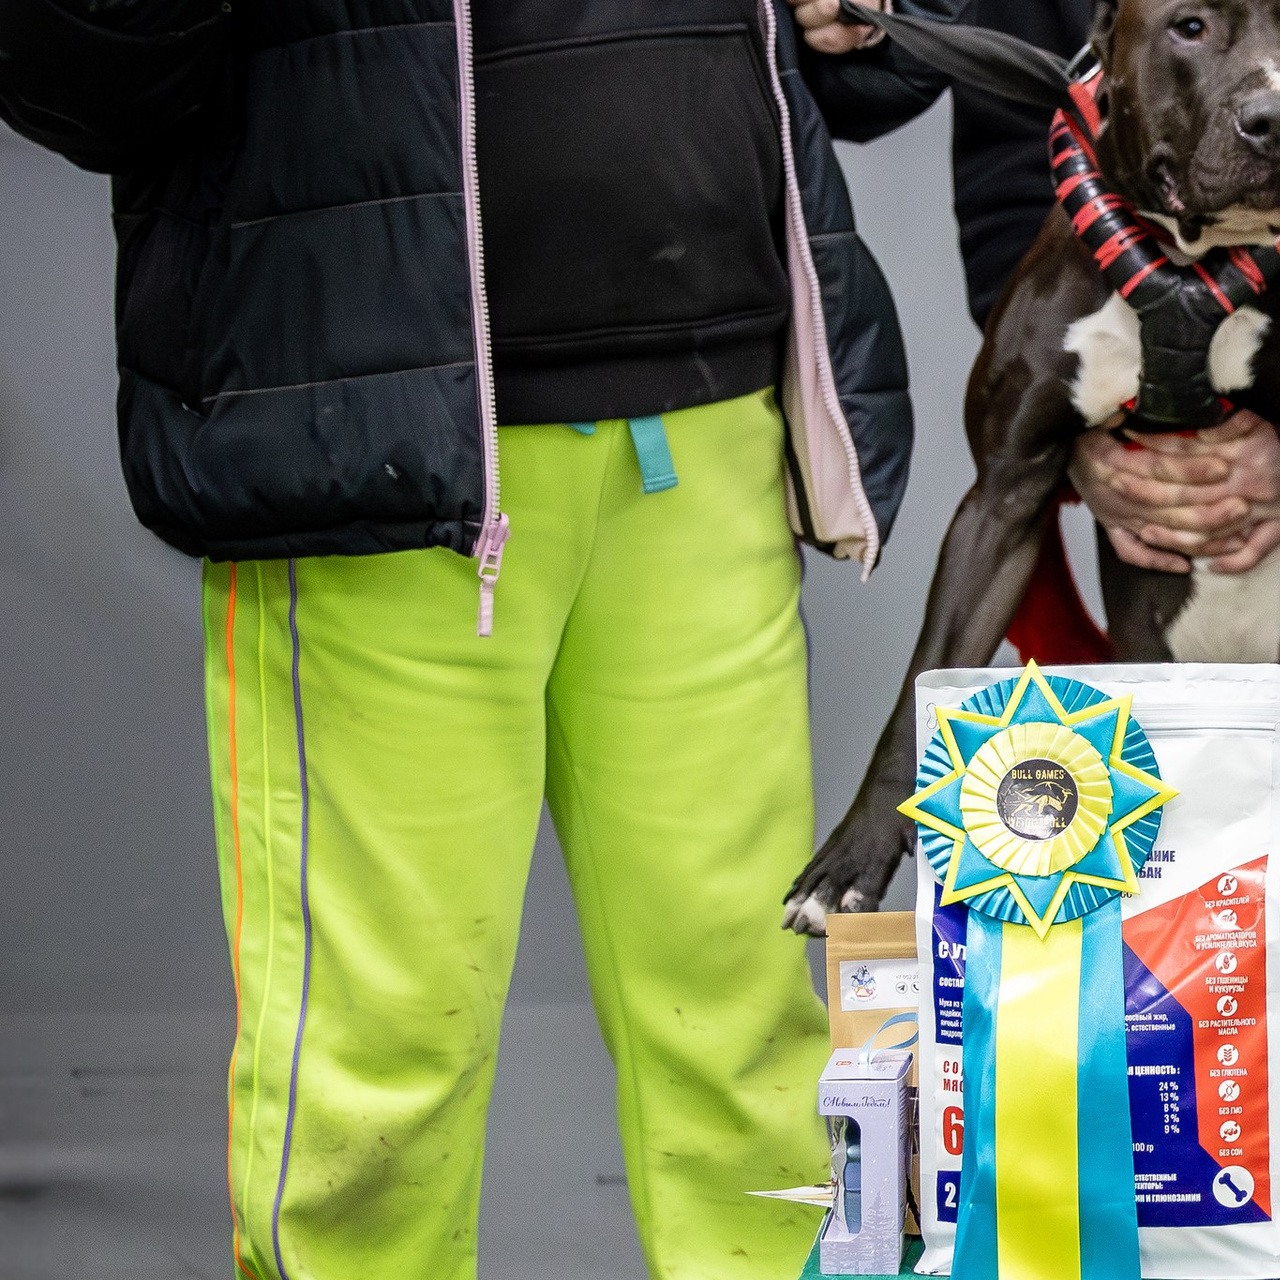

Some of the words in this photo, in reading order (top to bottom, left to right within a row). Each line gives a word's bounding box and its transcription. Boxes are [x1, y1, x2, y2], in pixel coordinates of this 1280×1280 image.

[1011, 769, 1033, 780] BULL
[1035, 769, 1066, 780] GAMES
[1205, 900, 1216, 909] БЕЗ
[1195, 934, 1206, 943] БЕЗ
[938, 940, 949, 960] С
[1205, 976, 1216, 985] БЕЗ
[1216, 975, 1249, 985] ПШЕНИЦЫ
[1214, 984, 1245, 994] КУКУРУЗЫ
[1131, 1023, 1176, 1032] естественные
[1198, 1020, 1210, 1028] БЕЗ
[1210, 1017, 1256, 1028] РАСТИТЕЛЬНОГО
[1218, 1027, 1239, 1036] МАСЛА
[1209, 1069, 1221, 1077] БЕЗ
[1221, 1068, 1248, 1077] ГЛЮТЕНА
[1158, 1081, 1168, 1091] 24
[1169, 1081, 1179, 1091] %
[1160, 1092, 1169, 1102] 13
[1170, 1092, 1179, 1102] %
[1163, 1103, 1169, 1113] 8
[1170, 1103, 1179, 1112] %
[1218, 1107, 1230, 1115] БЕЗ
[1230, 1106, 1243, 1114] ГМО
[1164, 1114, 1169, 1123] 3
[1170, 1114, 1180, 1123] %
[1164, 1125, 1170, 1134] 9
[1170, 1124, 1180, 1134] %
[1218, 1148, 1230, 1157] БЕЗ
[1230, 1147, 1243, 1156] СОИ
[1152, 1193, 1201, 1203] ГЛЮКОЗАМИН
